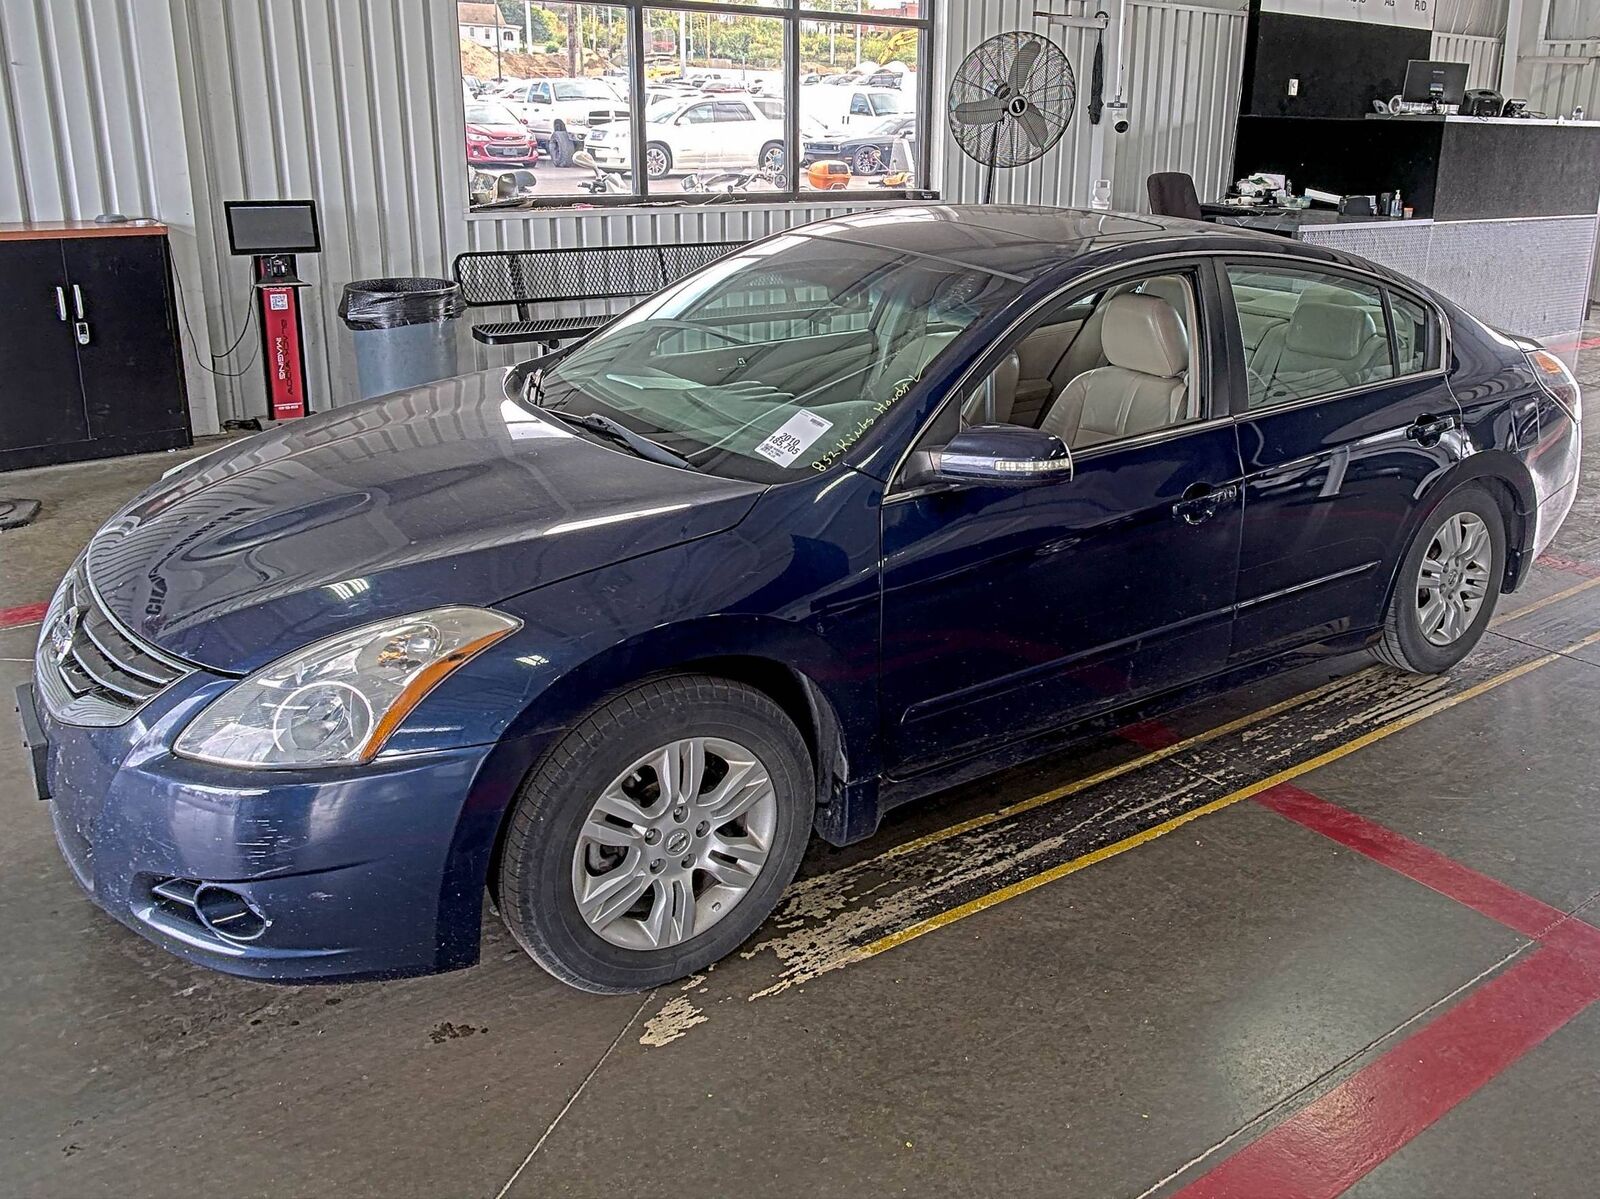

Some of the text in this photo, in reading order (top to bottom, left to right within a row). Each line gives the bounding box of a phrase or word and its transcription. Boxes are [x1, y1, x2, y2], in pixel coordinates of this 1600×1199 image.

[275, 337, 286, 380] IMAGING
[769, 435, 801, 455] 185,705
[780, 432, 801, 447] 2010
